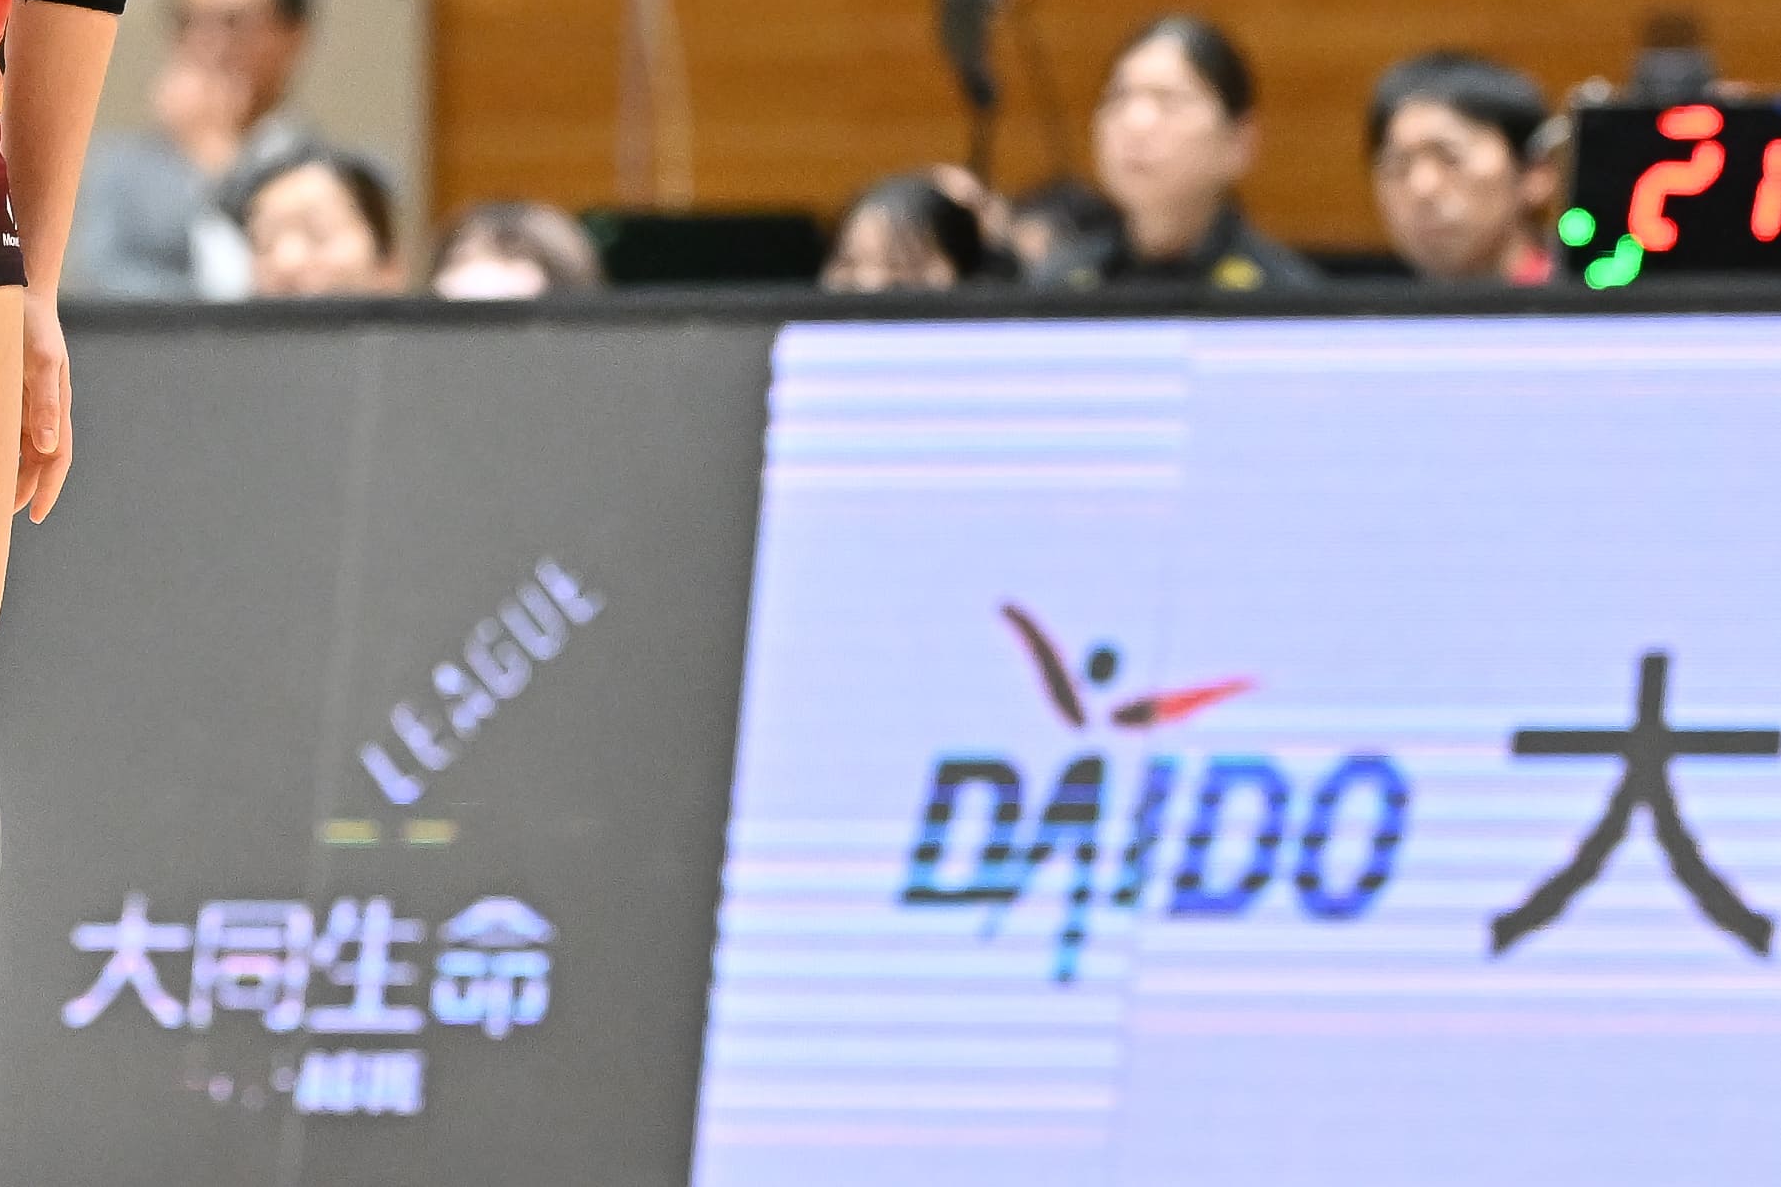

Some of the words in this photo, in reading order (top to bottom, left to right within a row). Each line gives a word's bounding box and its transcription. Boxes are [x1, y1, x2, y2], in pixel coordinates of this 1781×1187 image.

[900, 753, 1410, 983] DAIDO
[62, 891, 556, 1041] 大同生命
